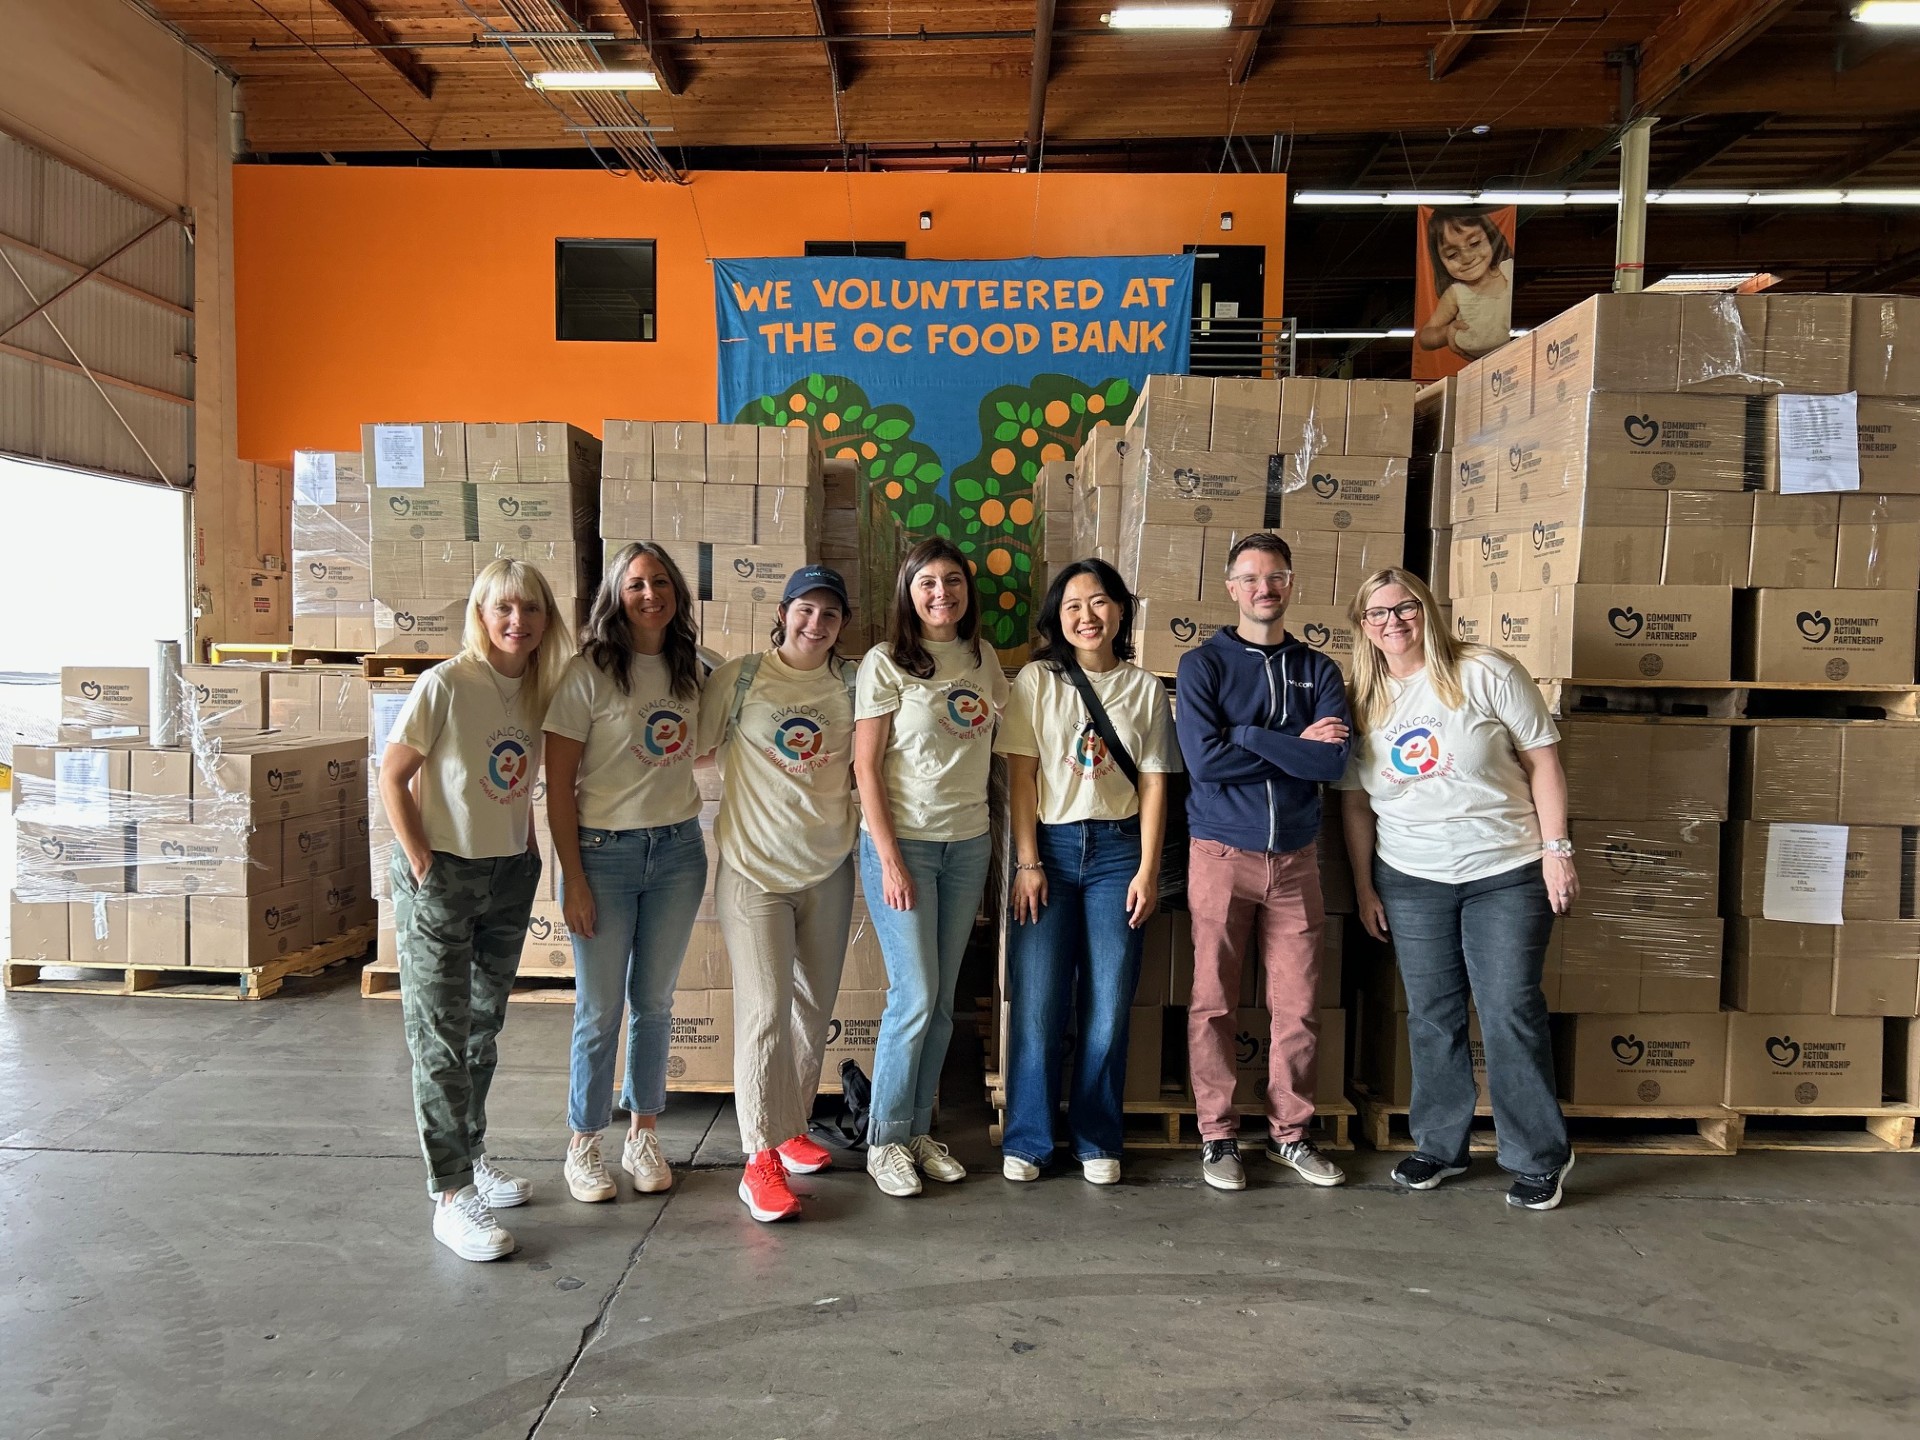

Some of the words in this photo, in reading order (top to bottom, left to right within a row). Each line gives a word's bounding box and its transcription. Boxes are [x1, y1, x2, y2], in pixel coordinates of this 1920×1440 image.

[732, 279, 792, 312] WE
[812, 277, 1104, 311] VOLUNTEERED
[1120, 278, 1175, 309] AT
[758, 322, 837, 354] THE
[853, 323, 913, 354] OC
[928, 323, 1040, 356] FOOD
[1052, 320, 1169, 354] BANK
[1662, 421, 1707, 430] COMMUNITY
[1858, 424, 1892, 433] MMUNITY
[1662, 430, 1688, 439] ACTION
[1858, 433, 1874, 442] TION
[1661, 440, 1712, 448] PARTNERSHIP
[1858, 443, 1897, 451] RTNERSHIP
[1646, 613, 1692, 622] COMMUNITY
[1834, 618, 1879, 626] COMMUNITY
[1834, 627, 1861, 635] ACTION
[1646, 632, 1697, 640] PARTNERSHIP
[1834, 636, 1884, 644] PARTNERSHIP
[1287, 680, 1314, 688] EVLCORP
[638, 698, 690, 719] EVALCORP
[771, 705, 831, 726] EVALCORP
[1384, 716, 1442, 741] EVALCORP
[486, 726, 533, 748] EVALCORP
[845, 1019, 882, 1027] COMMUNIT
[671, 1026, 697, 1034] ACTION
[670, 1035, 719, 1043] PARTNERSHIP
[844, 1037, 878, 1045] PARTNER
[1647, 1041, 1691, 1049] COMMUNITY
[1802, 1042, 1846, 1051] COMMUNITY
[1803, 1051, 1829, 1060] ACTION
[1646, 1059, 1695, 1067] PARTNERSHIP
[1802, 1061, 1851, 1069] PARTNERSHIP
